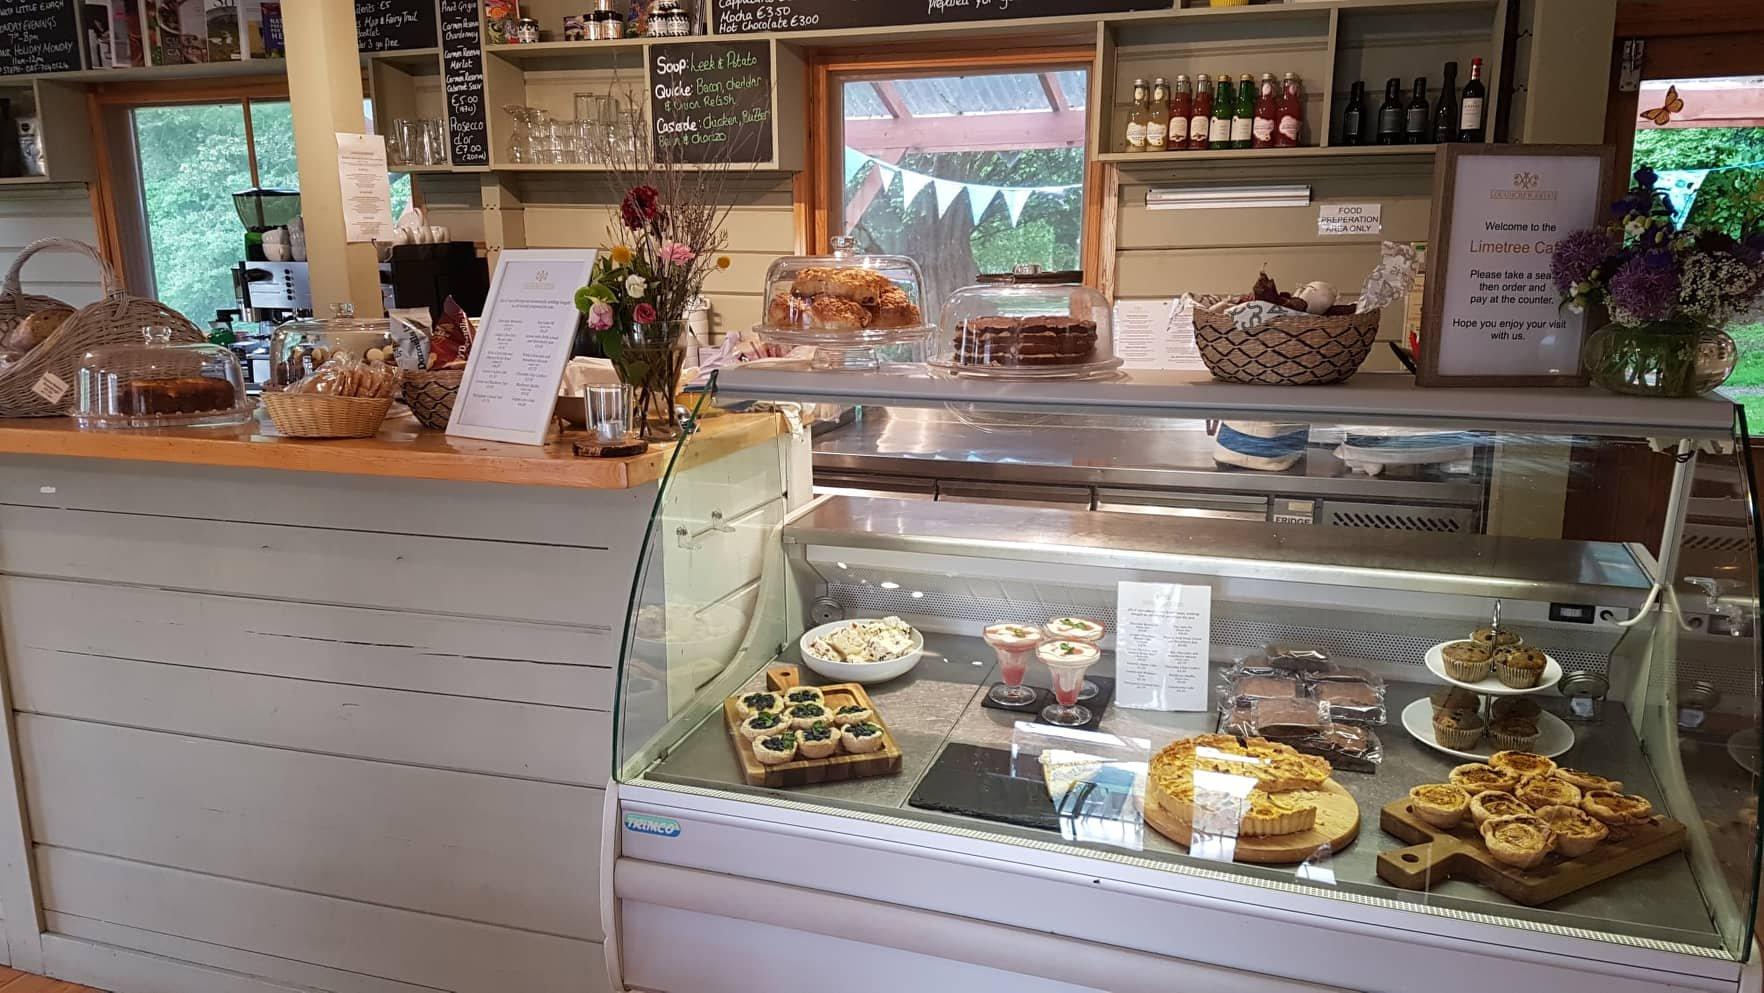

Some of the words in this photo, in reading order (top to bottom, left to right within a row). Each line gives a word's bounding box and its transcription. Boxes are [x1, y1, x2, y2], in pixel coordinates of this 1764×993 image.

[720, 10, 753, 23] Mocha
[719, 23, 738, 33] Hot
[742, 18, 789, 31] Chocolate
[450, 59, 473, 69] Merlot
[656, 56, 690, 76] Soup:
[727, 50, 758, 69] Potato
[450, 116, 484, 132] Prosecco
[691, 132, 727, 144] Chorizo
[1485, 221, 1528, 232] Welcome
[1530, 222, 1540, 232] to
[1542, 221, 1557, 232] the
[1470, 240, 1530, 254] Limetree
[1470, 269, 1502, 280] Please
[1504, 270, 1525, 280] take
[1527, 272, 1533, 280] a
[1535, 271, 1554, 280] sea
[1479, 282, 1500, 292] then
[1502, 282, 1527, 292] order
[1528, 282, 1546, 292] and
[1470, 296, 1487, 305] pay
[1489, 295, 1499, 304] at
[1501, 295, 1516, 304] the
[1518, 295, 1554, 304] counter.
[1452, 319, 1478, 330] Hope
[1480, 321, 1497, 330] you
[1499, 320, 1524, 330] enjoy
[1526, 321, 1547, 330] your
[1549, 319, 1566, 329] visit
[1491, 331, 1509, 340] with
[1512, 332, 1526, 340] us.
[1275, 516, 1311, 524] FRIDGE
